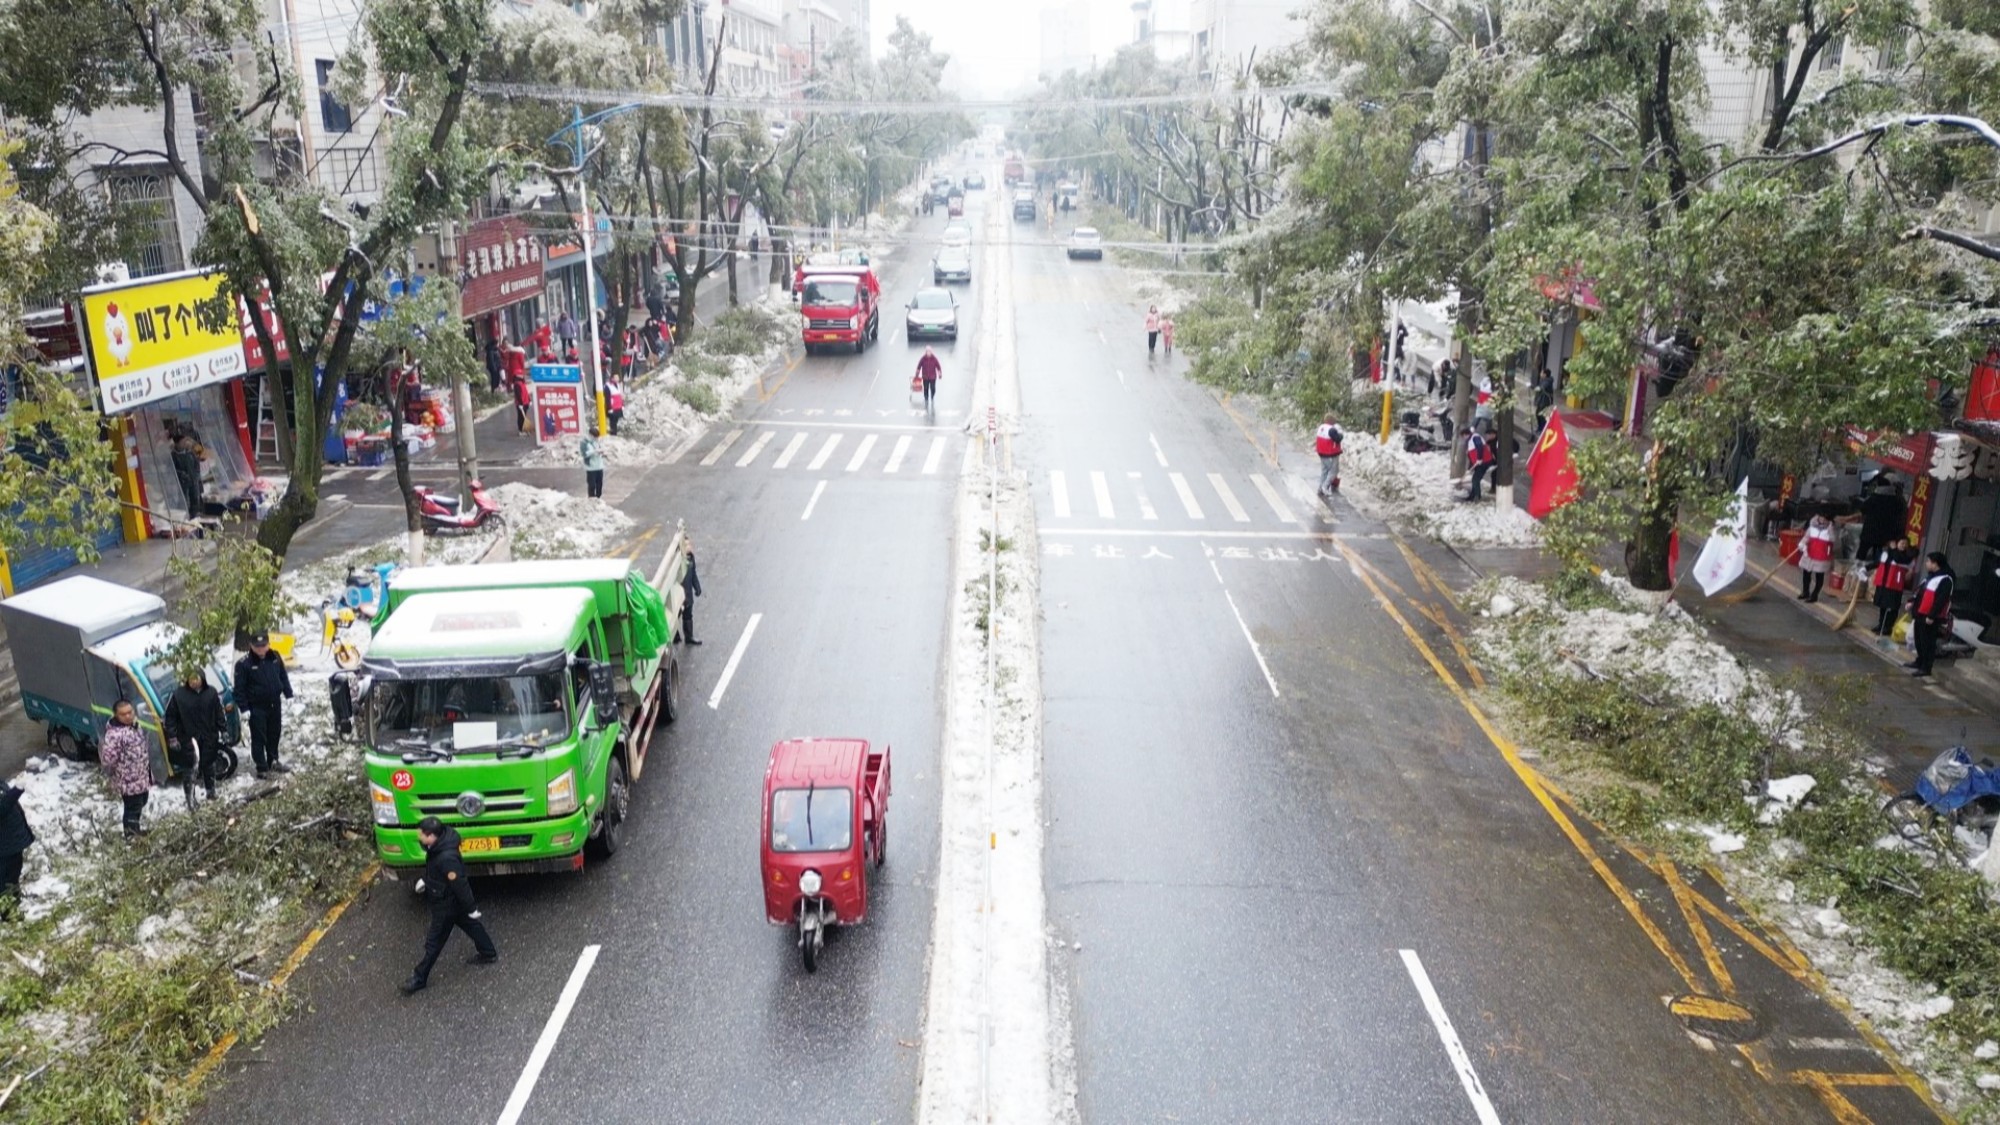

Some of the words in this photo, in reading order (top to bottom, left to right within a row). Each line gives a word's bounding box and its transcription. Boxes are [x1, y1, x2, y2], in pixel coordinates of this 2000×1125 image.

[1043, 543, 1174, 559] 车让人
[1218, 546, 1342, 562] 车让人
[395, 772, 411, 788] 23
